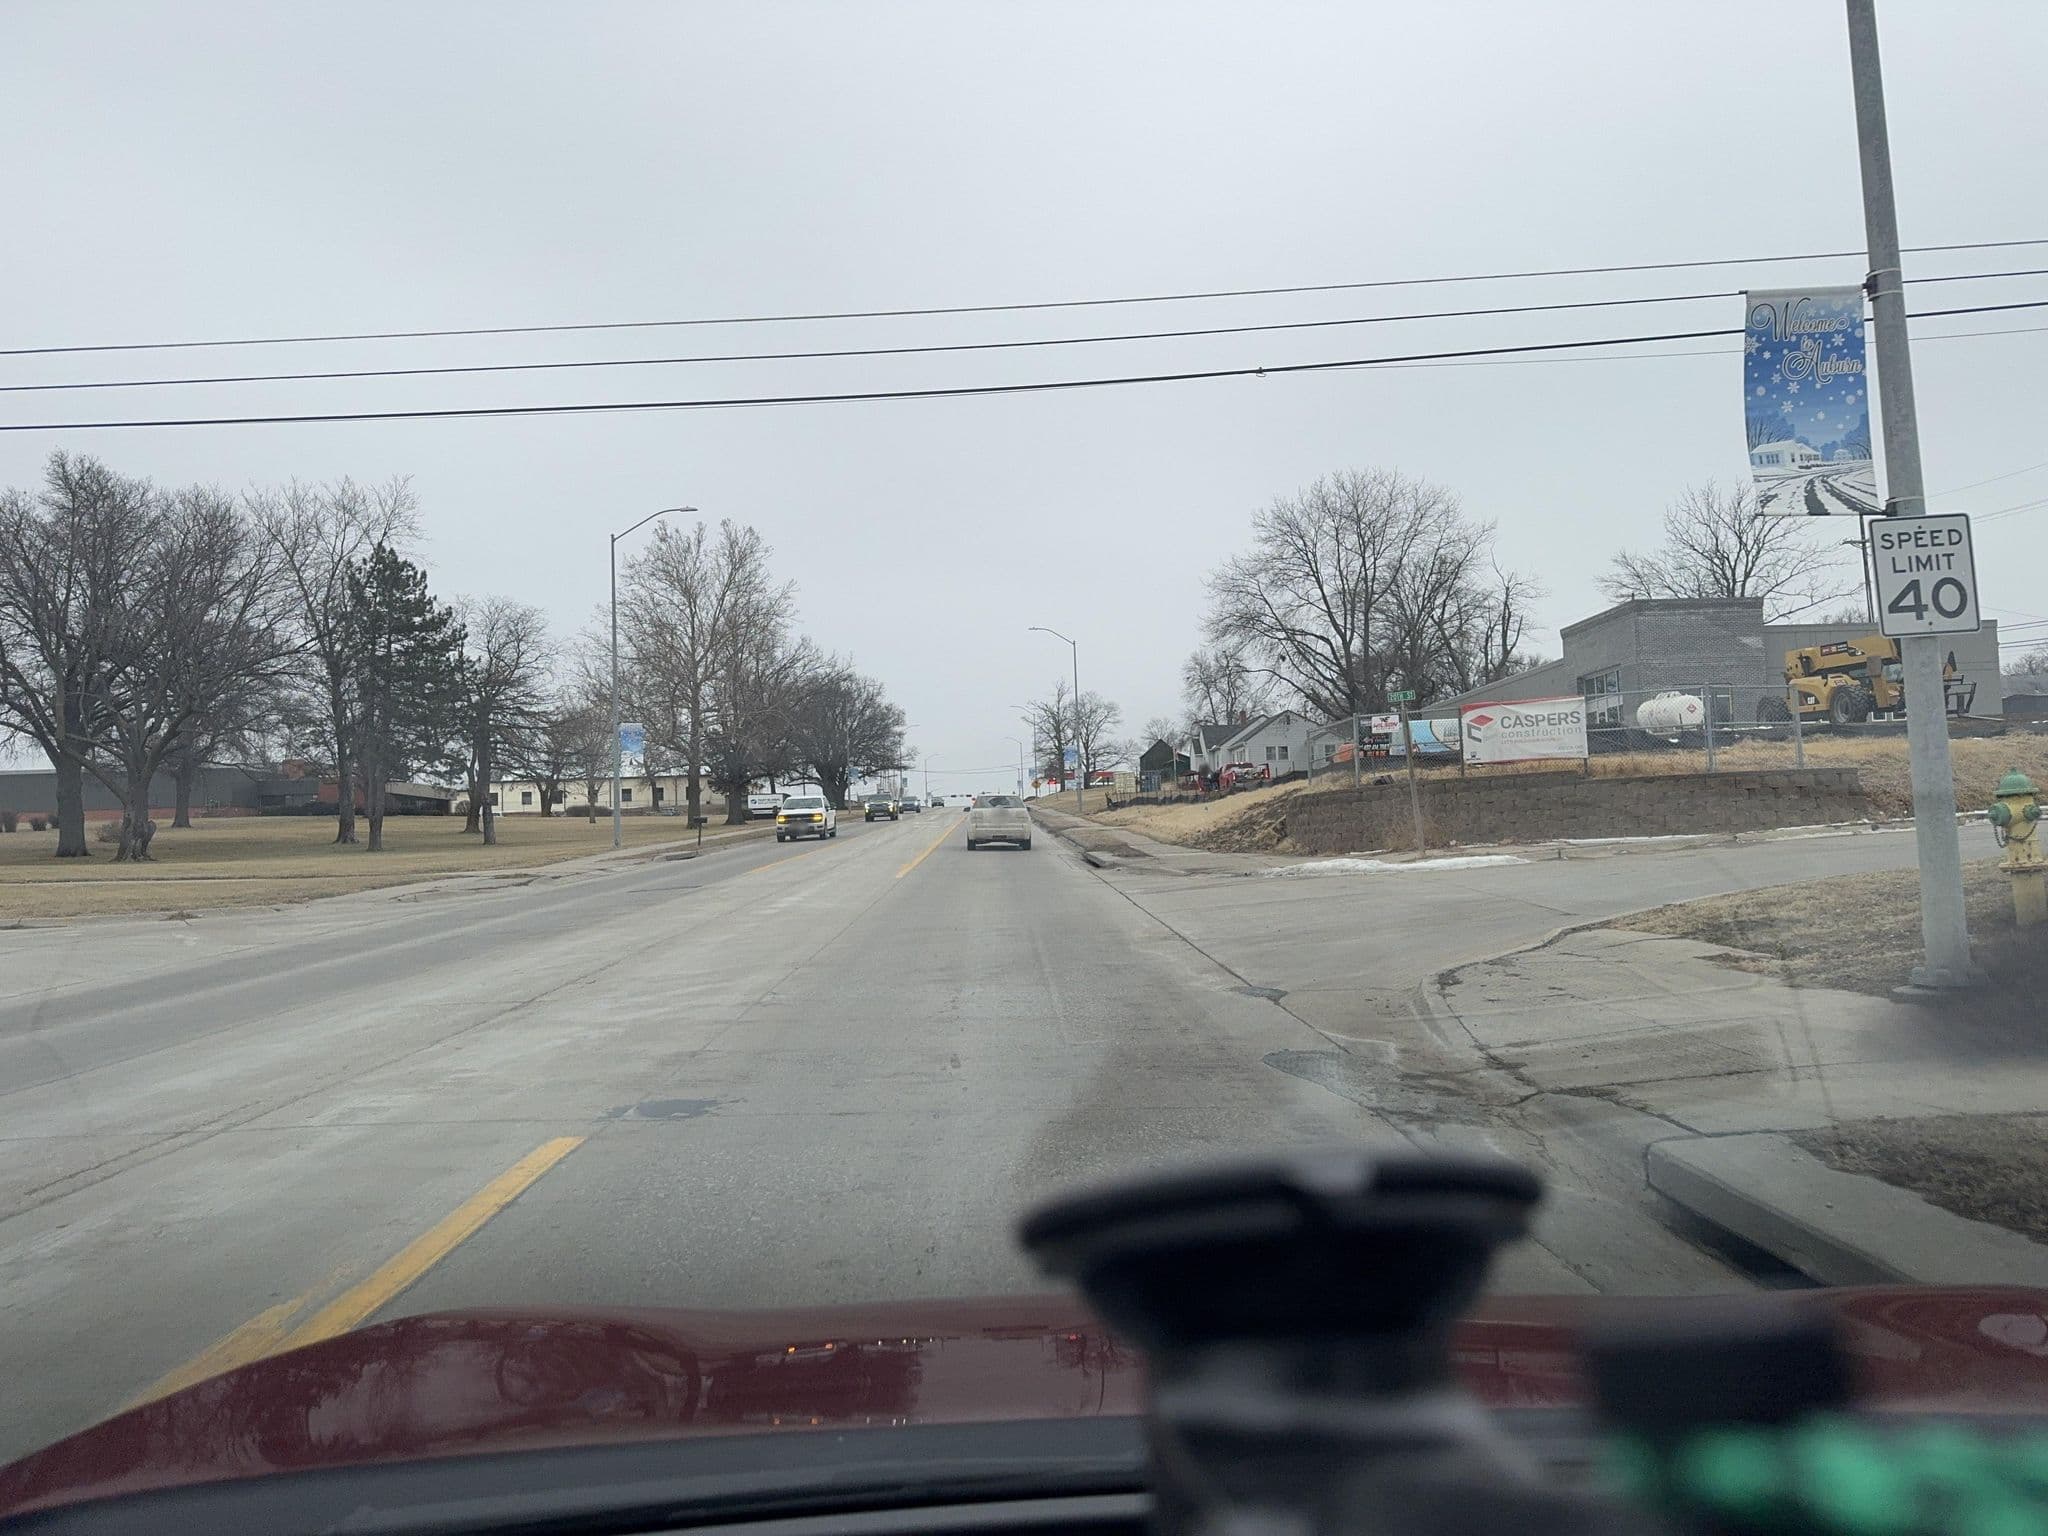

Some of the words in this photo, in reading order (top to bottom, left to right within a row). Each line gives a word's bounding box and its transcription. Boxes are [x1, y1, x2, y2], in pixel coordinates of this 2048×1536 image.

[1751, 297, 1850, 342] Welcome
[1782, 340, 1862, 384] Auburn
[1881, 529, 1963, 550] SPEED
[1892, 552, 1955, 574] LIMIT
[1887, 576, 1968, 621] 40
[1500, 711, 1581, 729] CASPERS
[1501, 726, 1582, 739] construction
